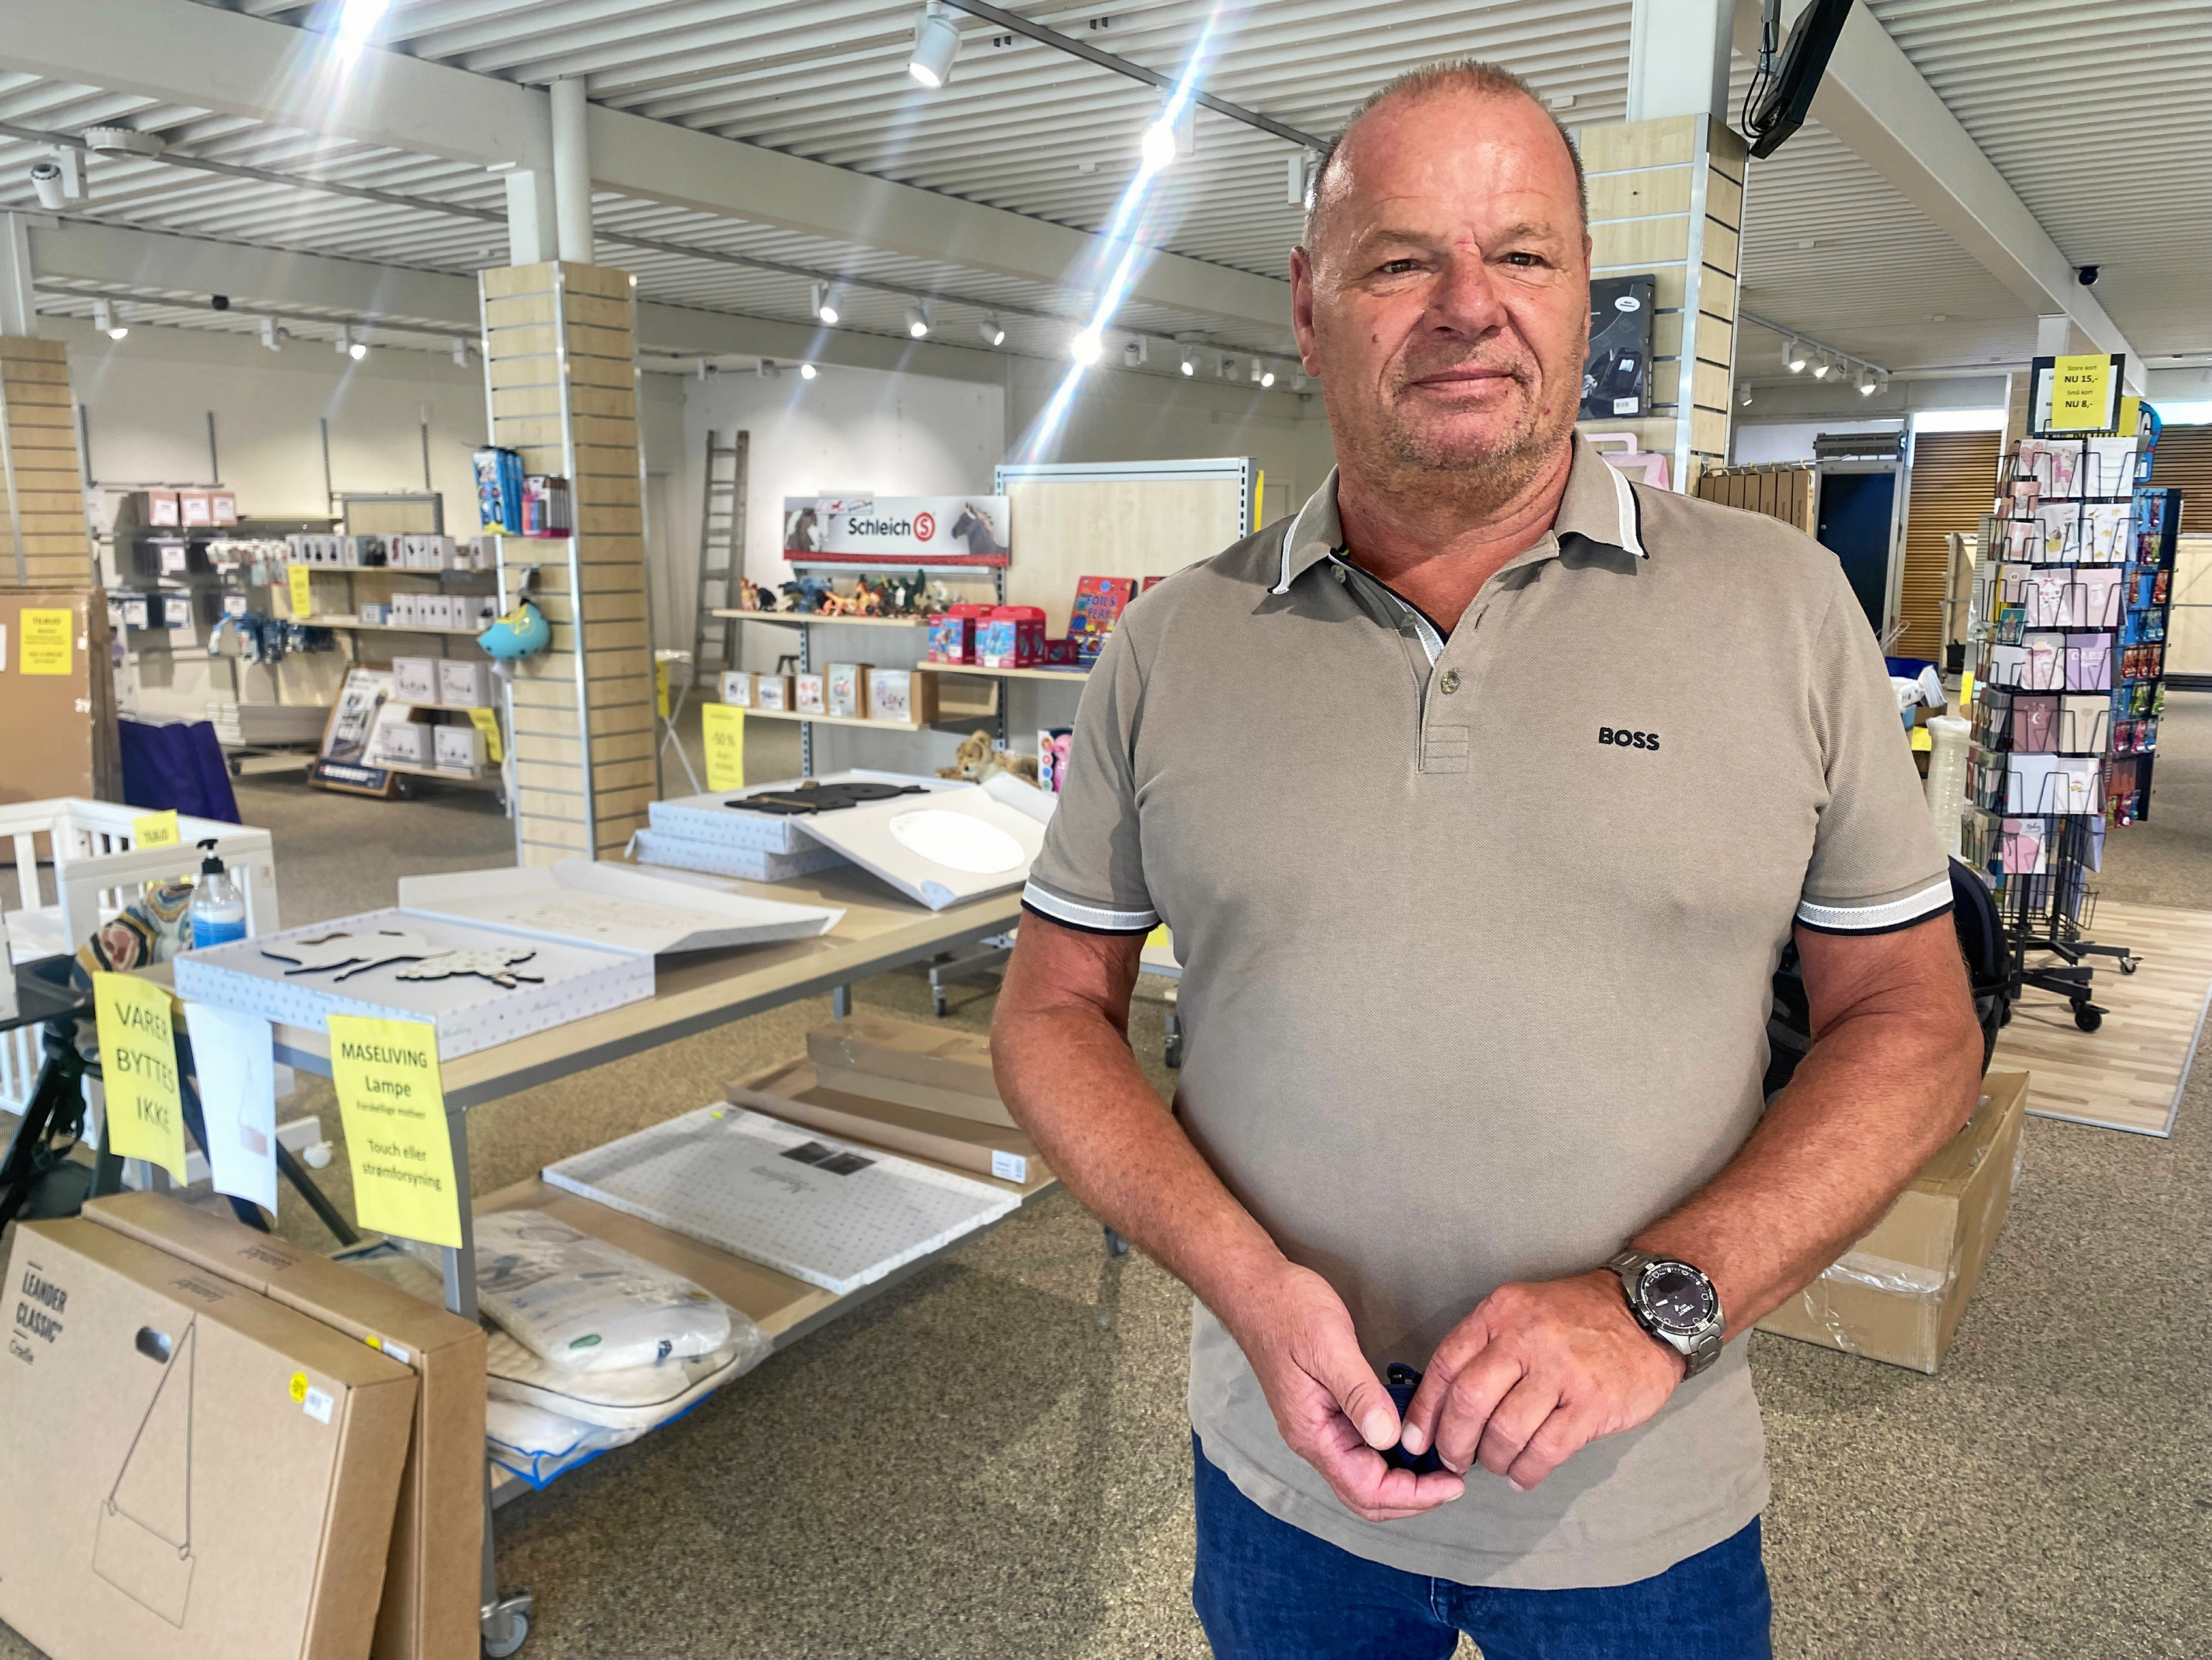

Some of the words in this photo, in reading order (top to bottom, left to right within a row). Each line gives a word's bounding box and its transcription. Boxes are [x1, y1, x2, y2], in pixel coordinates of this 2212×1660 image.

[2081, 375, 2098, 383] 15,-
[2081, 400, 2093, 409] 8,-
[848, 518, 911, 536] Schleich
[1086, 595, 1107, 607] FOIL
[1088, 608, 1111, 619] PLAY
[1599, 726, 1660, 751] BOSS
[114, 1000, 170, 1046] VARER
[341, 1043, 428, 1069] MASELIVING
[116, 1048, 175, 1094] BYTTES
[365, 1074, 412, 1100] Lampe
[136, 1094, 172, 1134] IKKE
[367, 1138, 400, 1157] Touch
[403, 1146, 427, 1162] eller
[362, 1161, 442, 1192] strømforsyning
[22, 1271, 68, 1315] LEANDER
